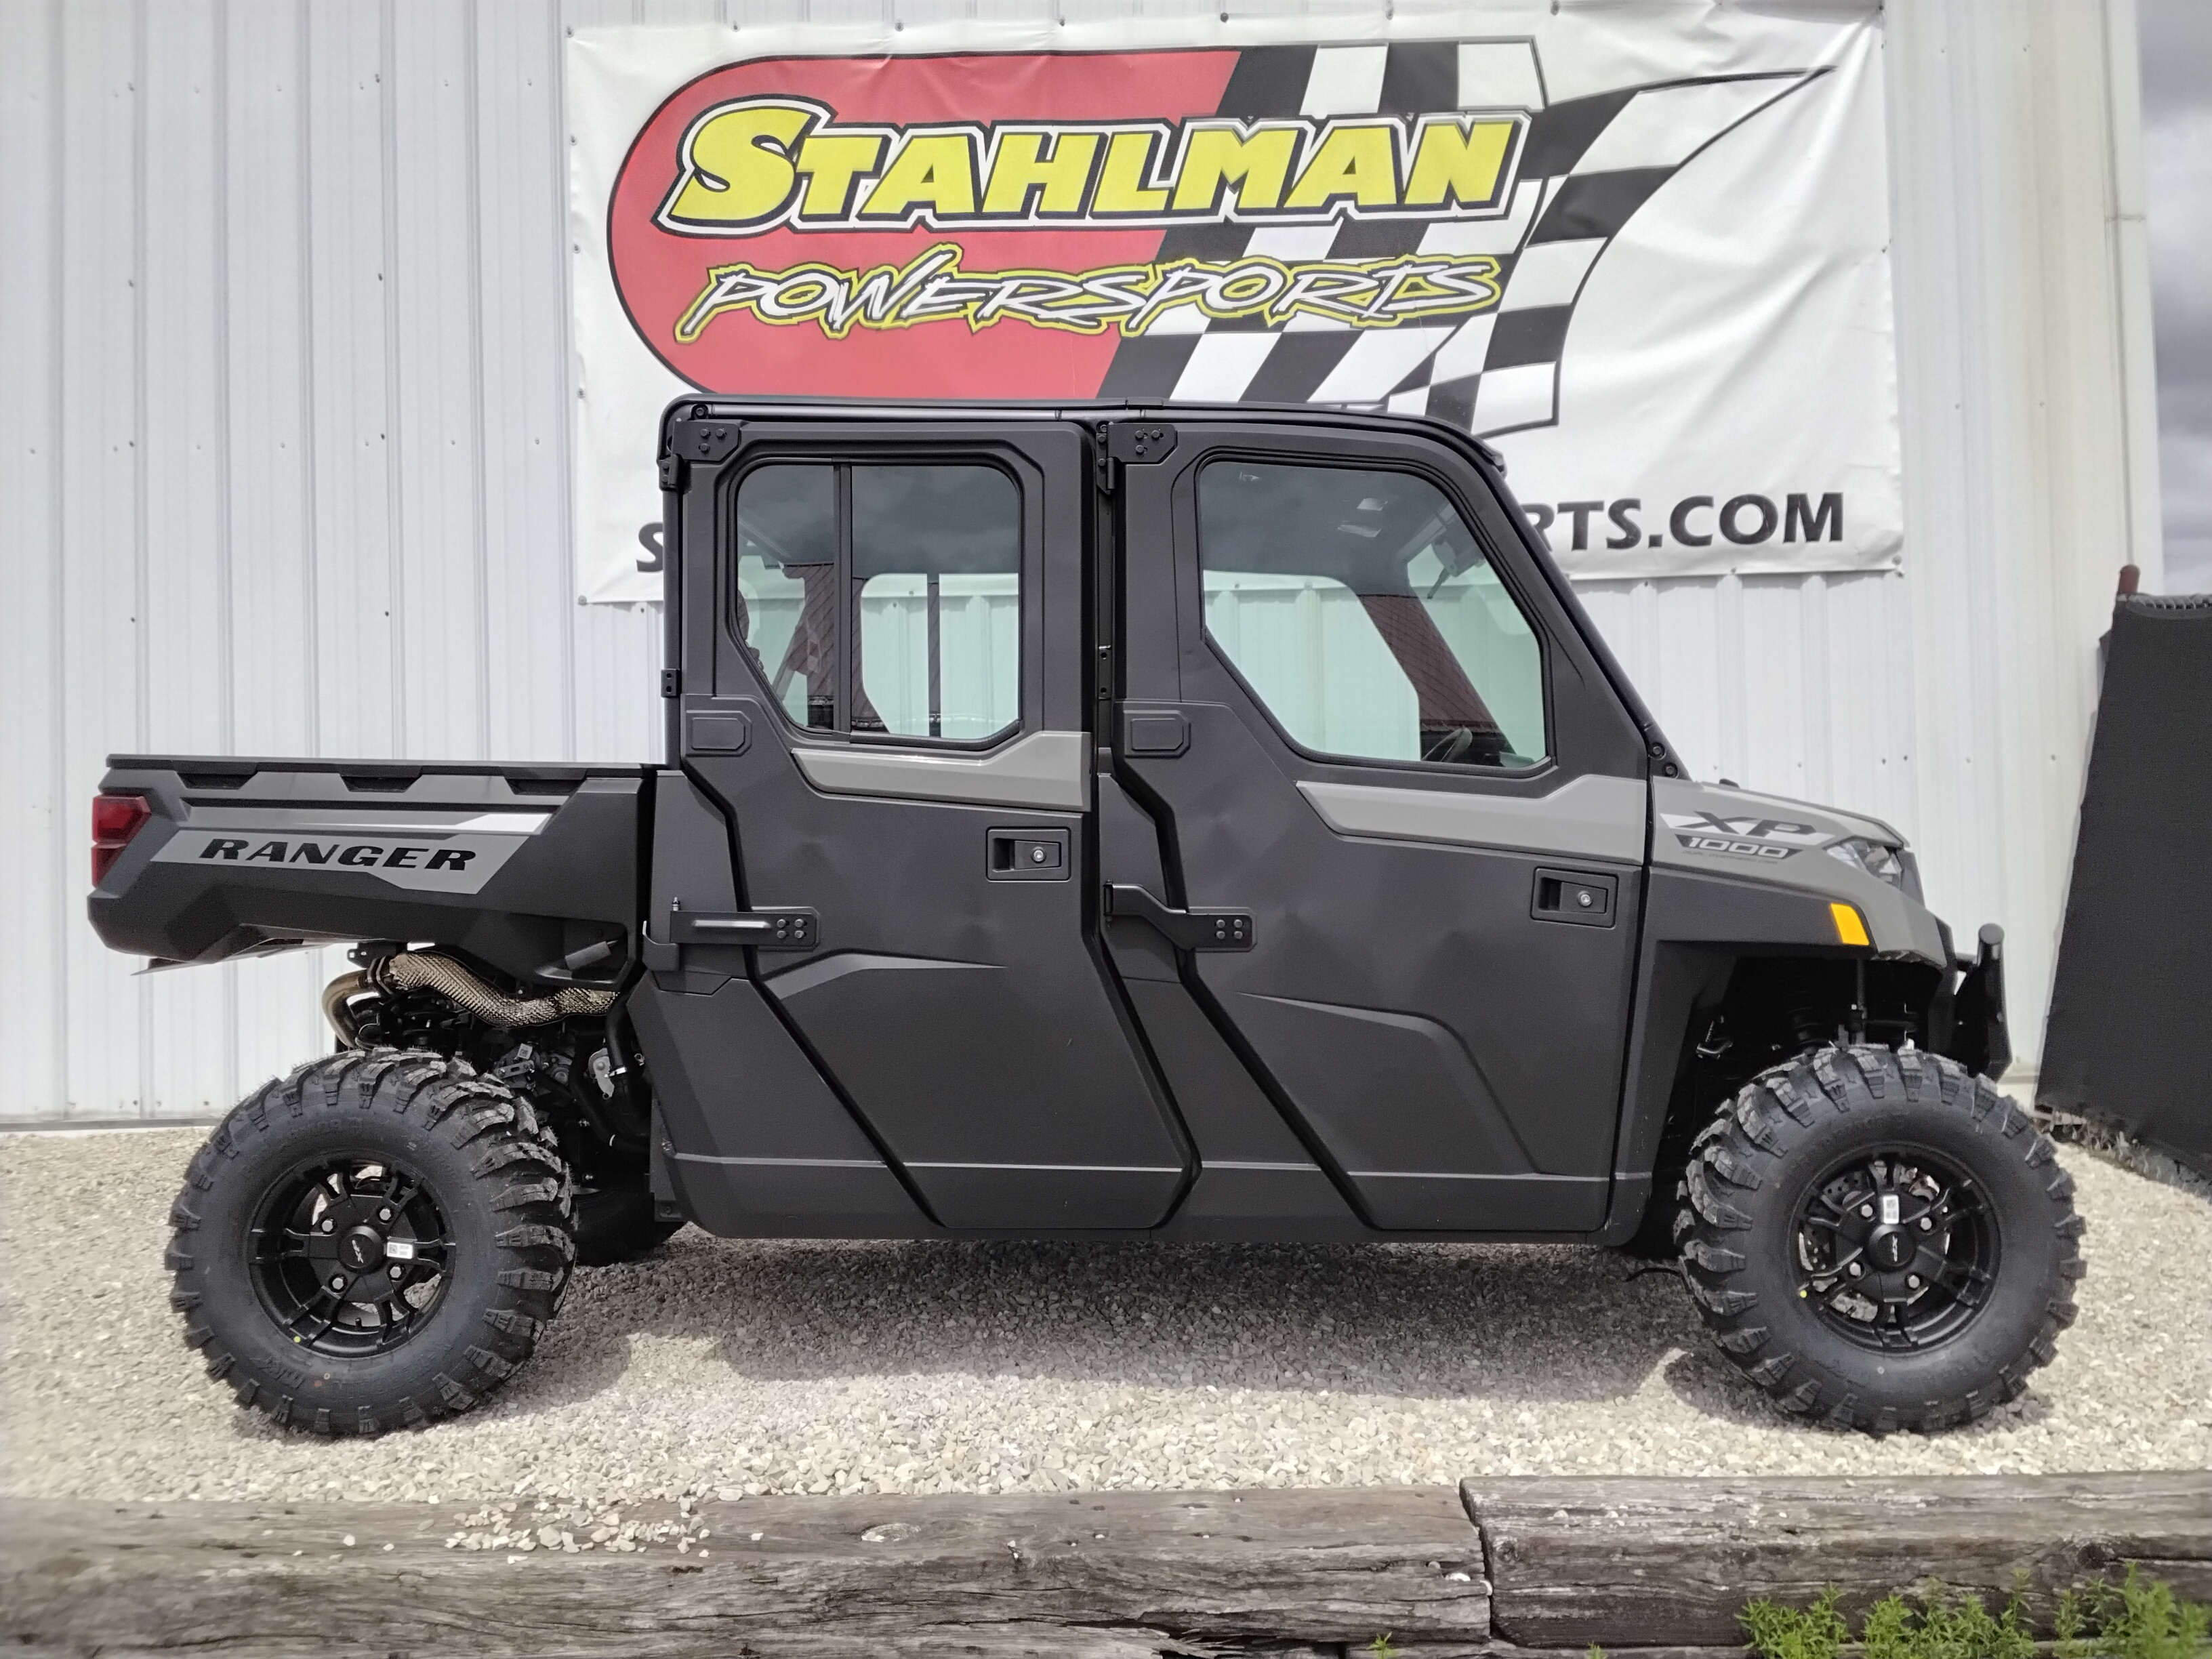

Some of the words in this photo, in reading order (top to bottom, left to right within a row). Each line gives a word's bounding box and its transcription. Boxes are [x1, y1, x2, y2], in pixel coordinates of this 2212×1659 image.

[655, 96, 1529, 236] STAHLMAN
[676, 245, 1500, 340] POWERSPORTS
[1675, 811, 1817, 838] XP
[199, 838, 476, 871] RANGER
[1688, 837, 1788, 859] 1000
